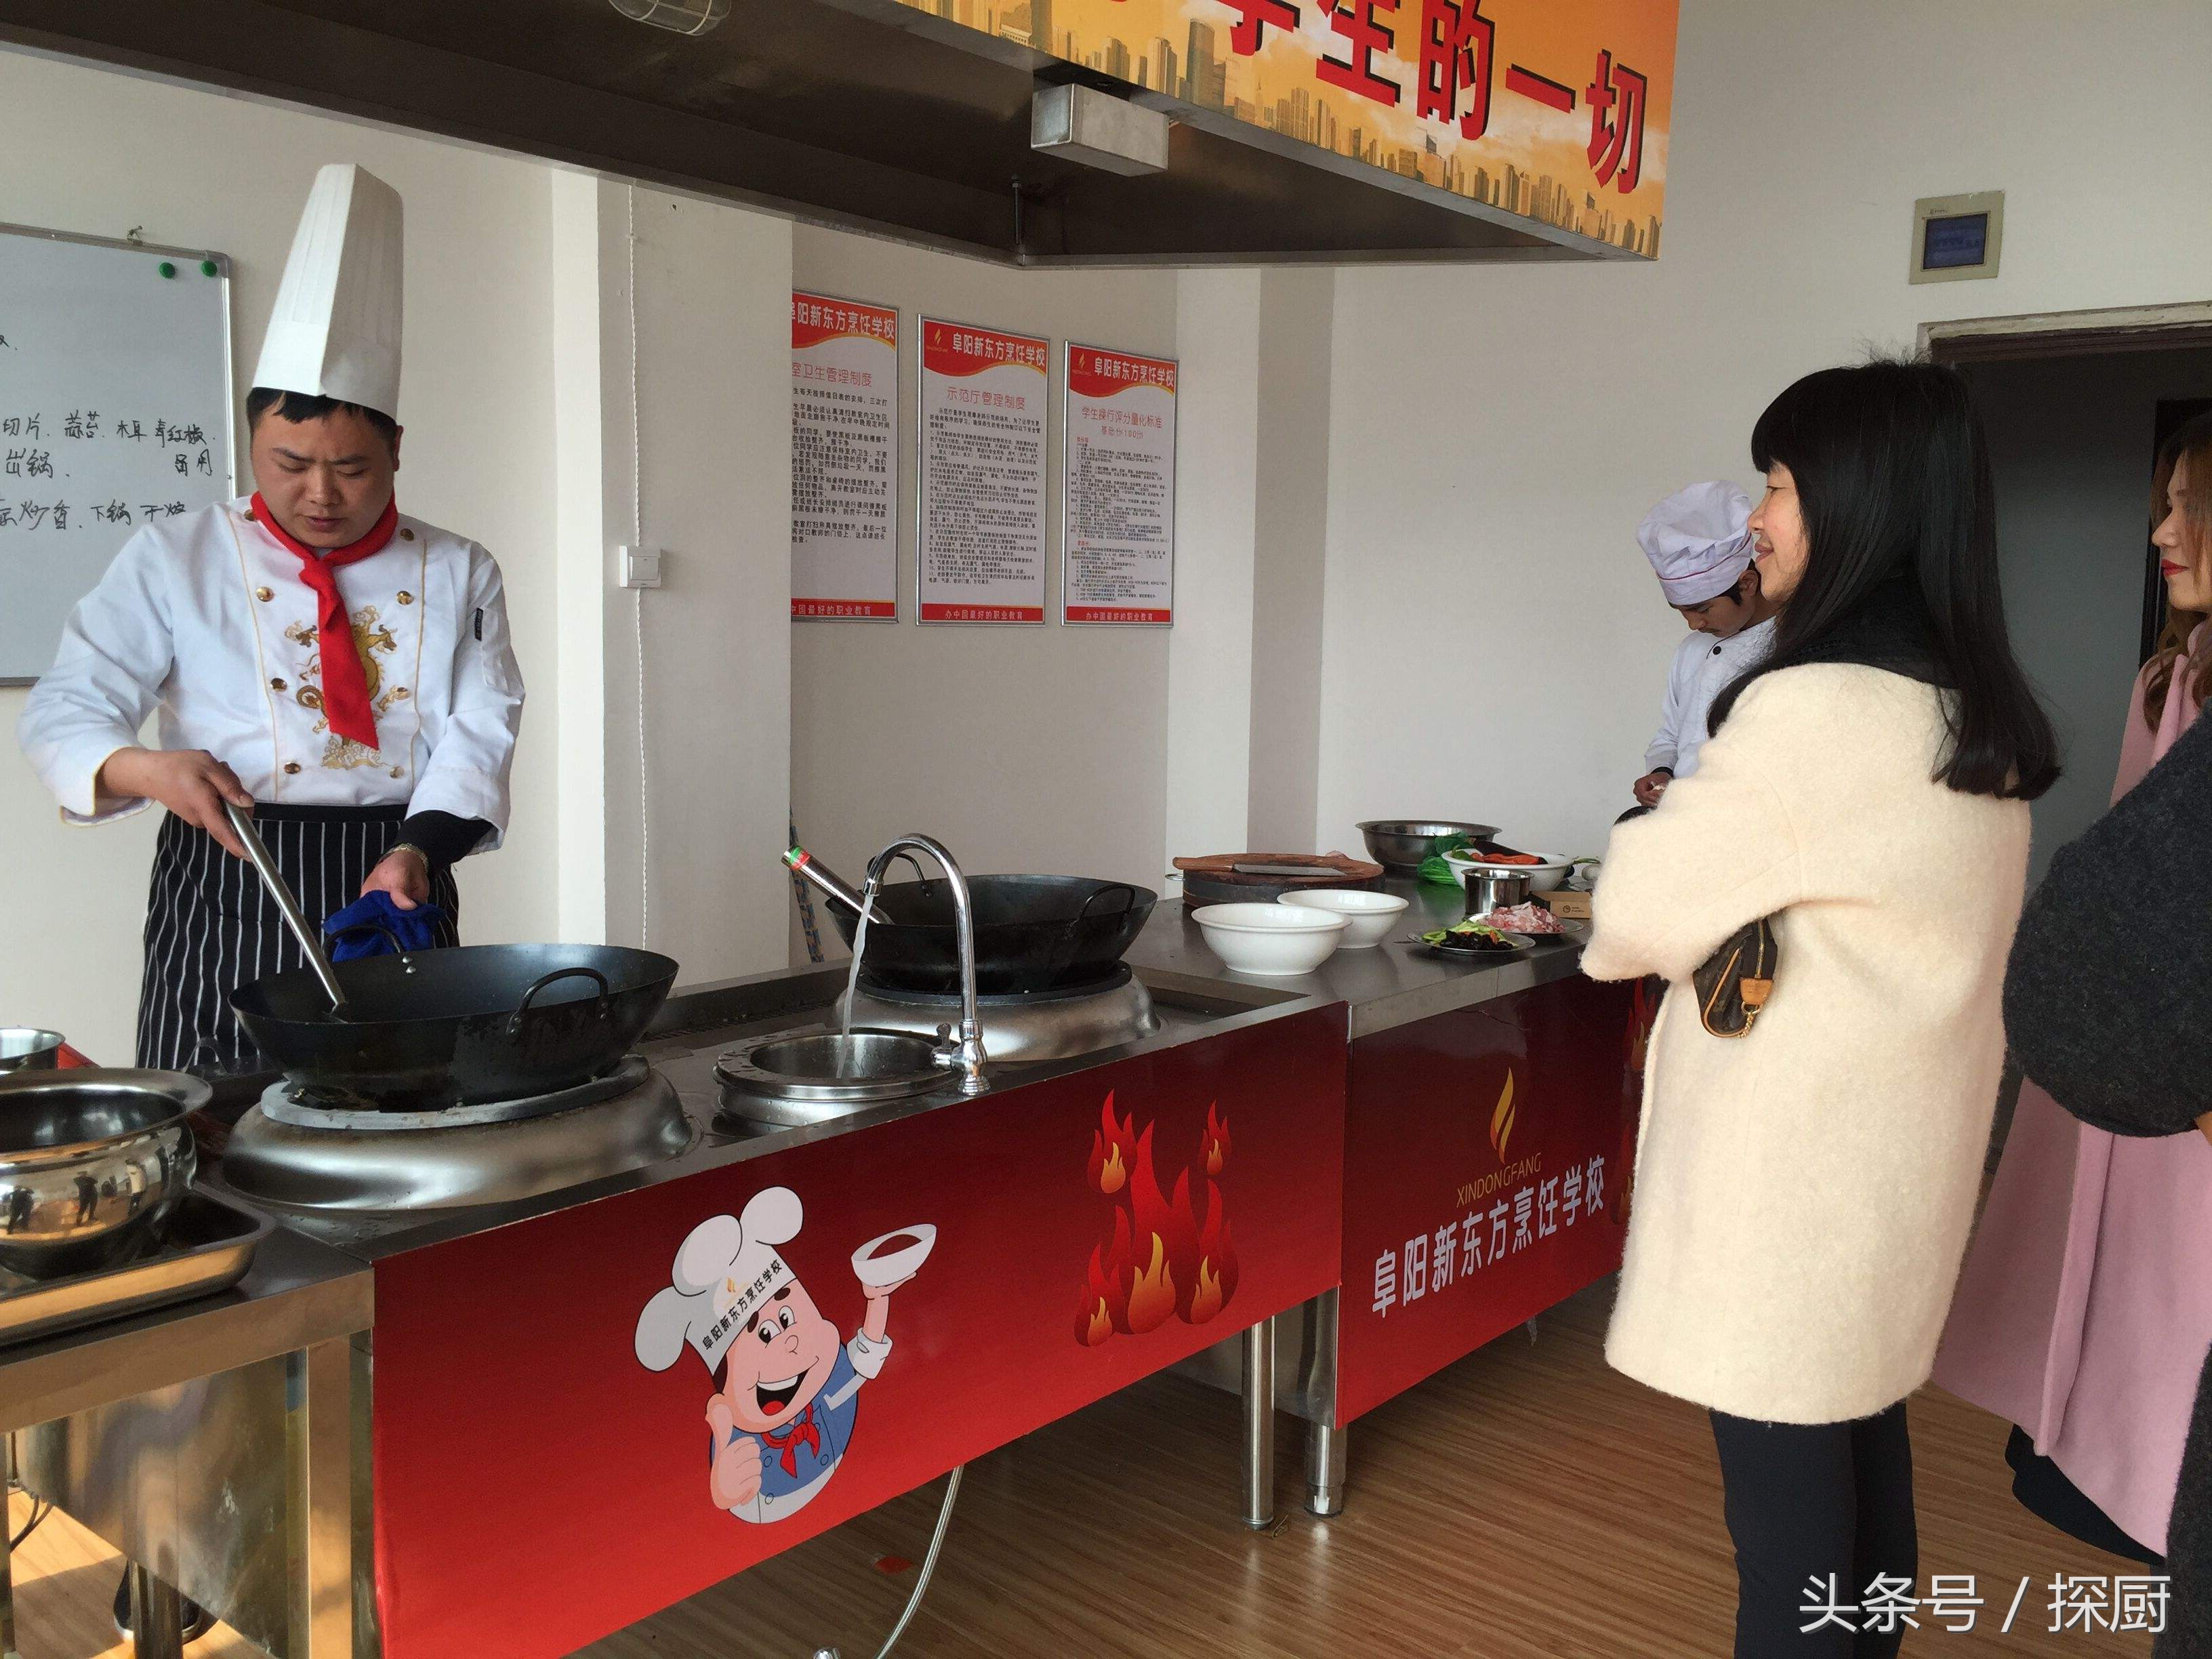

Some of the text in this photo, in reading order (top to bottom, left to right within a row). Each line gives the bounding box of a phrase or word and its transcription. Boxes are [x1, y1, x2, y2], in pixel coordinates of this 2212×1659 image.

[952, 332, 1046, 367] 阜阳新东方烹饪学校
[1094, 356, 1174, 387] 阜阳新东方烹饪学校
[947, 386, 1026, 413] 示范厅管理制度
[945, 610, 1023, 620] 办中国最好的职业教育
[1085, 612, 1153, 621] 办中国最好的职业教育
[1456, 1152, 1542, 1208] XINDONGFANG
[1372, 1154, 1605, 1318] 阜阳新东方烹饪学校
[702, 1259, 782, 1350] 阜阳新东方烹饪学校
